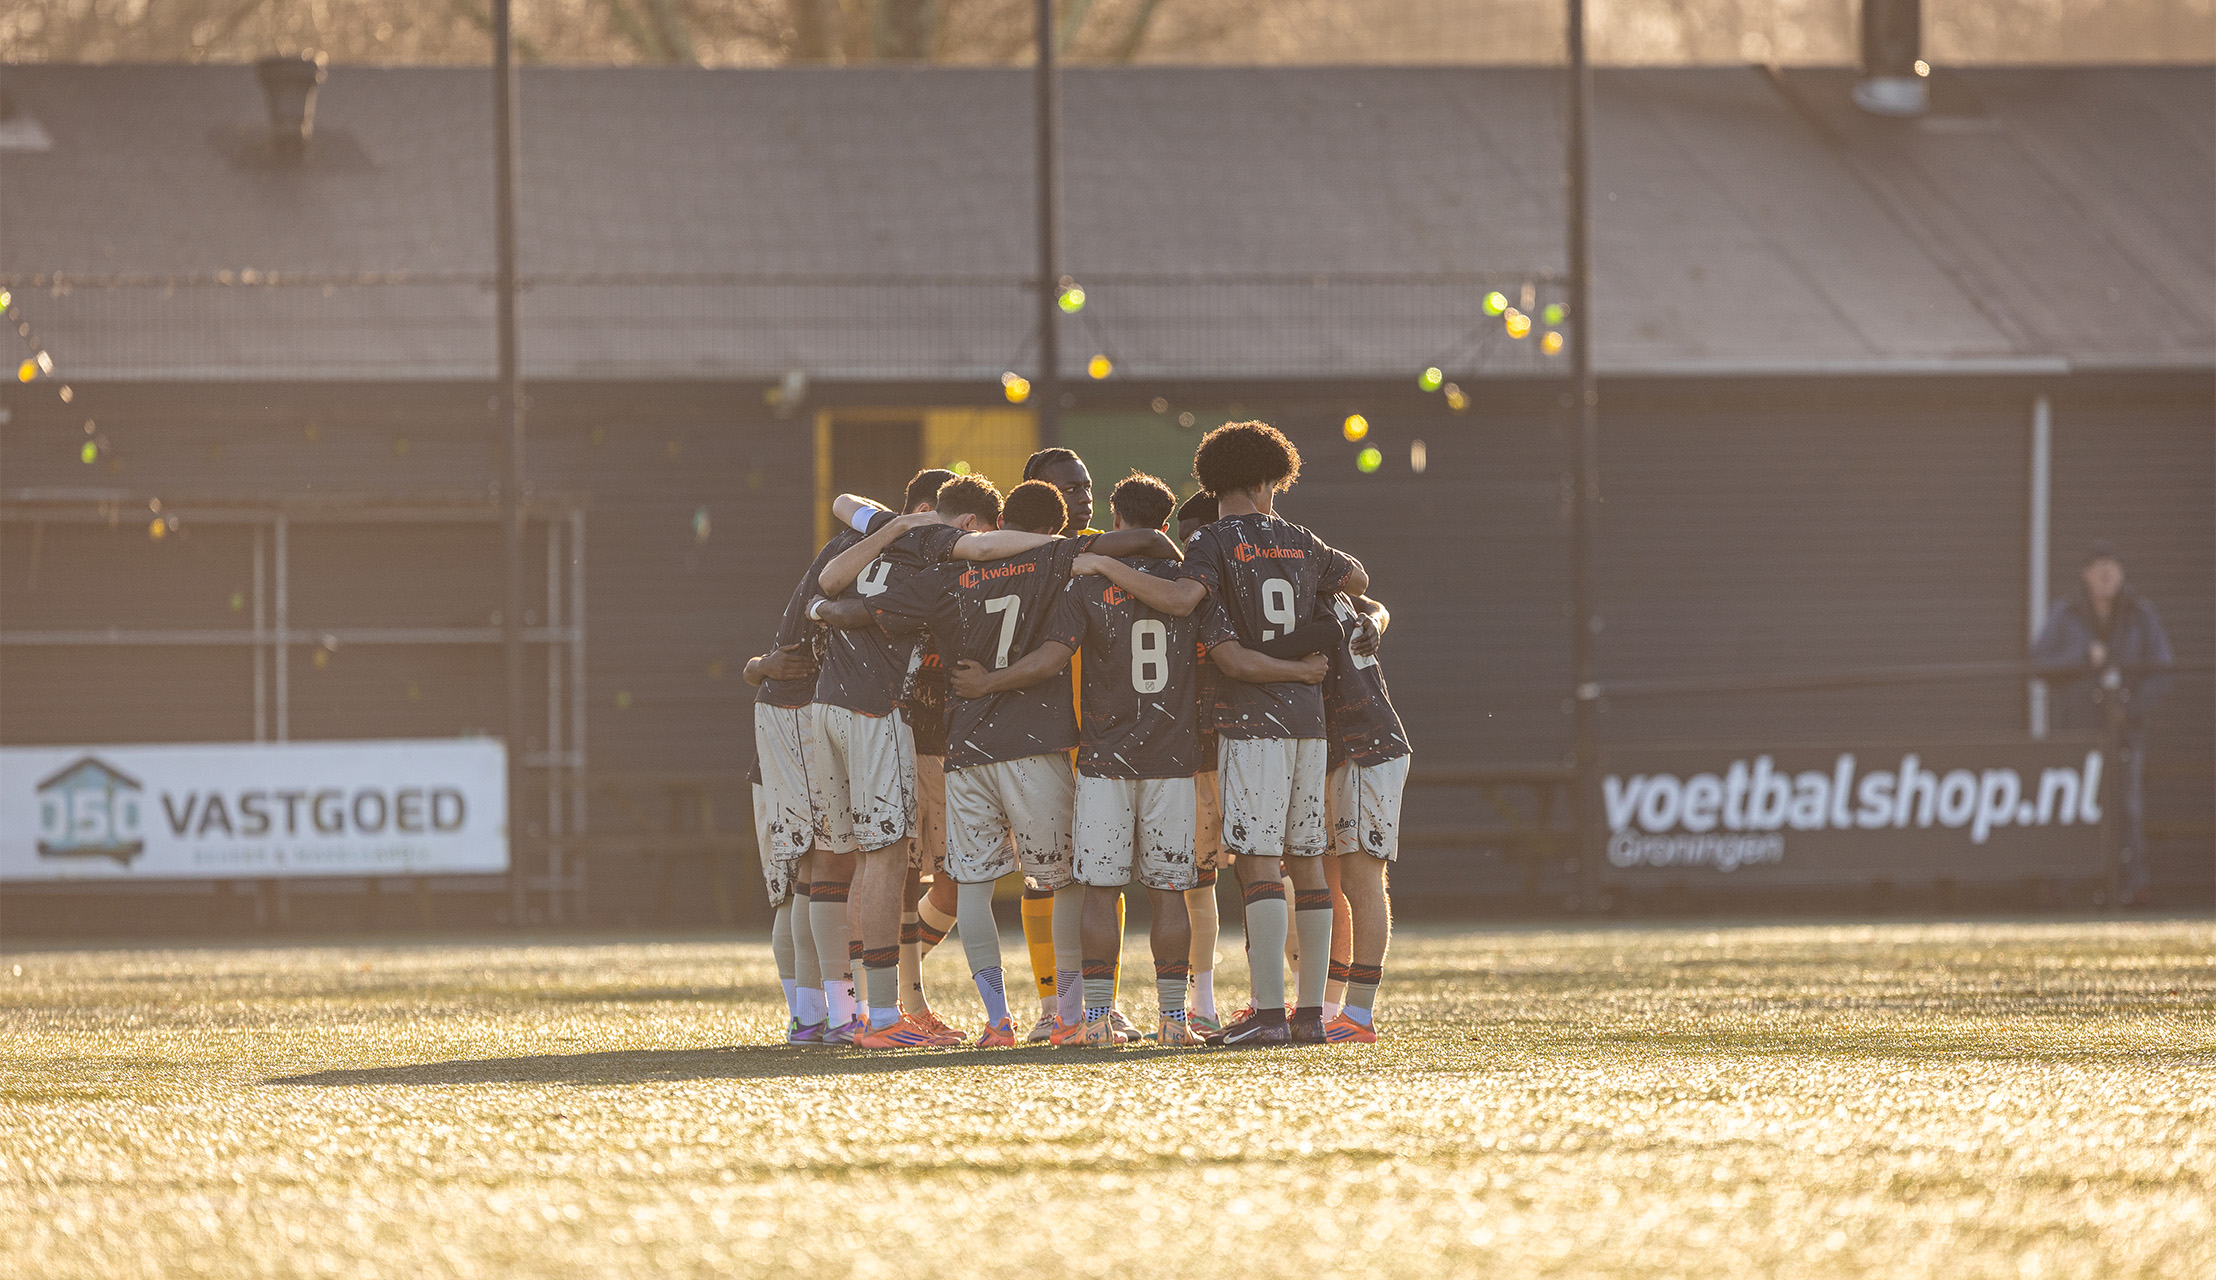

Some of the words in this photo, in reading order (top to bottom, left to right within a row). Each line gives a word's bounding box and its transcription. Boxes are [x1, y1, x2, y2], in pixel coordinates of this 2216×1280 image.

[981, 562, 1037, 581] kwakma
[1254, 543, 1305, 559] kwakman
[984, 594, 1021, 669] 7
[1261, 577, 1296, 642] 9
[1131, 619, 1169, 694] 8
[162, 788, 467, 837] VASTGOED
[1601, 751, 2102, 844] voetbalshop.nl
[1606, 828, 1785, 872] Groningen
